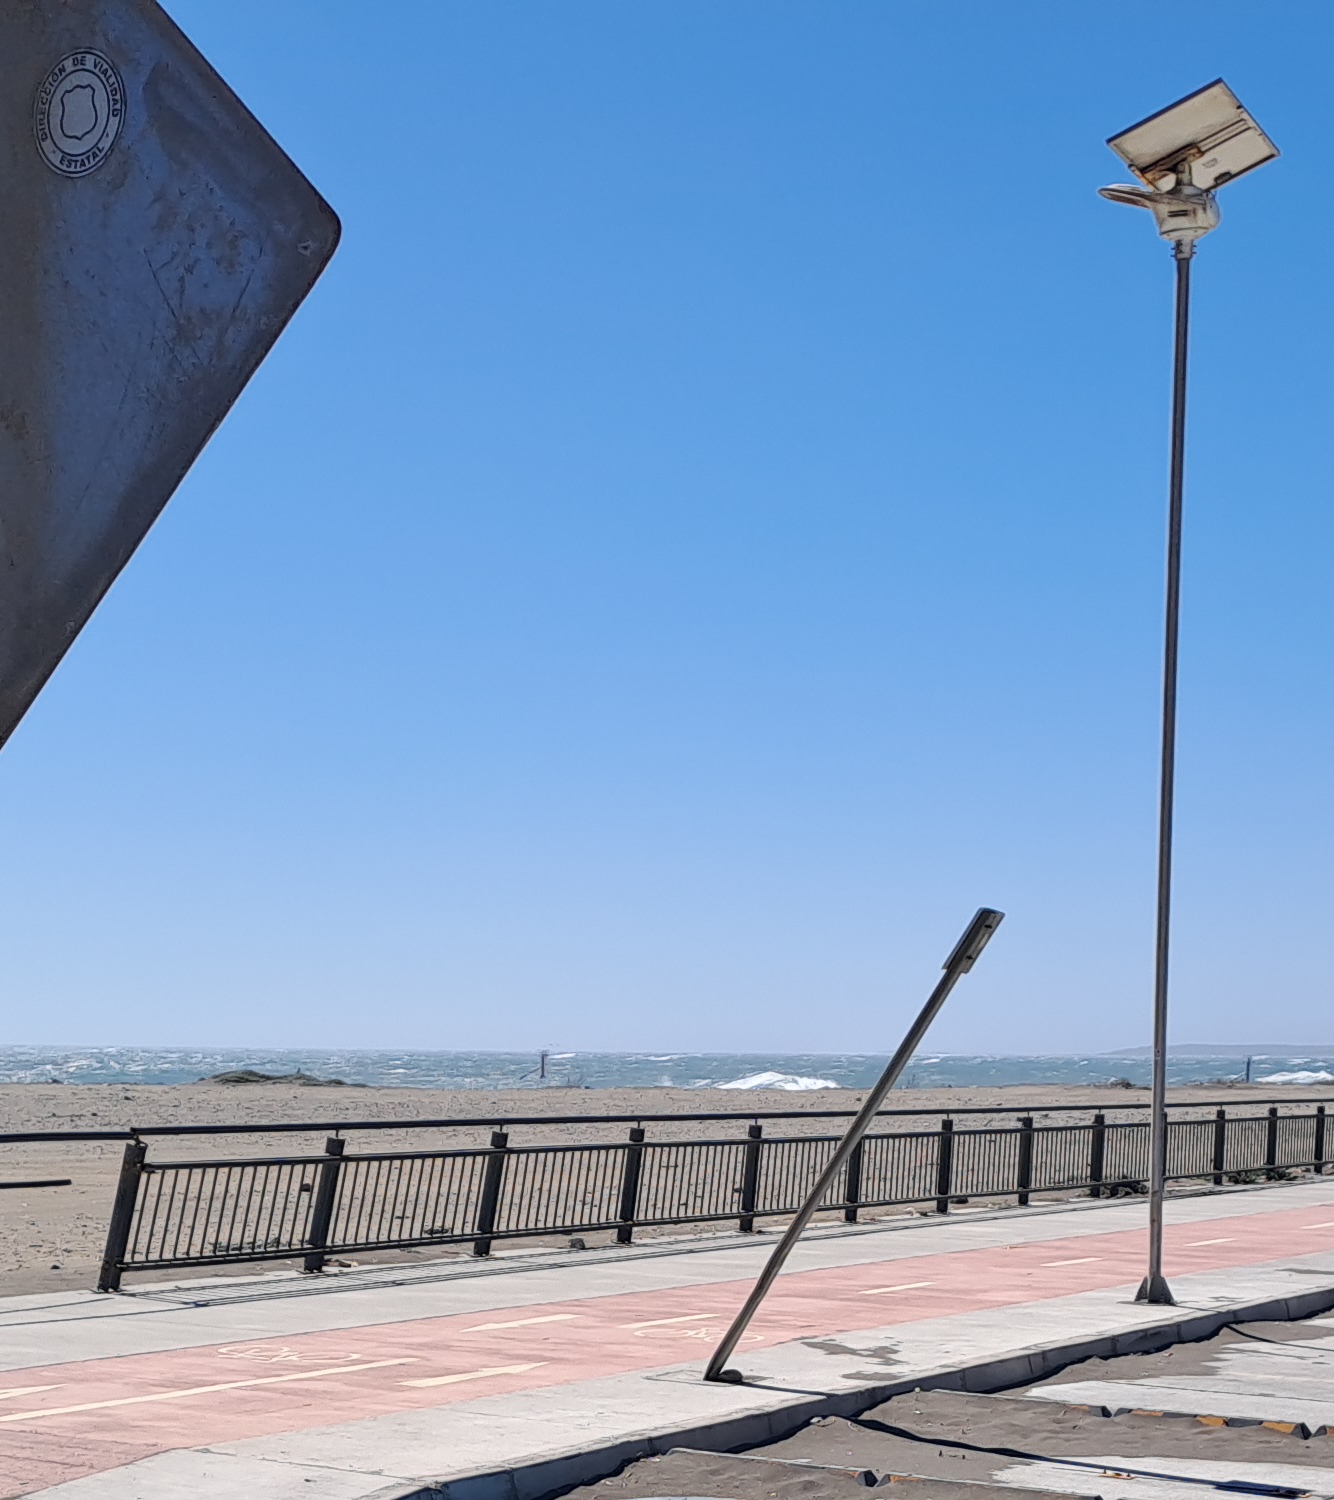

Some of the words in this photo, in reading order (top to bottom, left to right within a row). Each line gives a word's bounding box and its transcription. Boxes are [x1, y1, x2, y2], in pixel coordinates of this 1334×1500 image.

[72, 55, 87, 66] DE
[93, 58, 121, 118] VIALIDAD
[59, 145, 105, 169] ESTATAL
